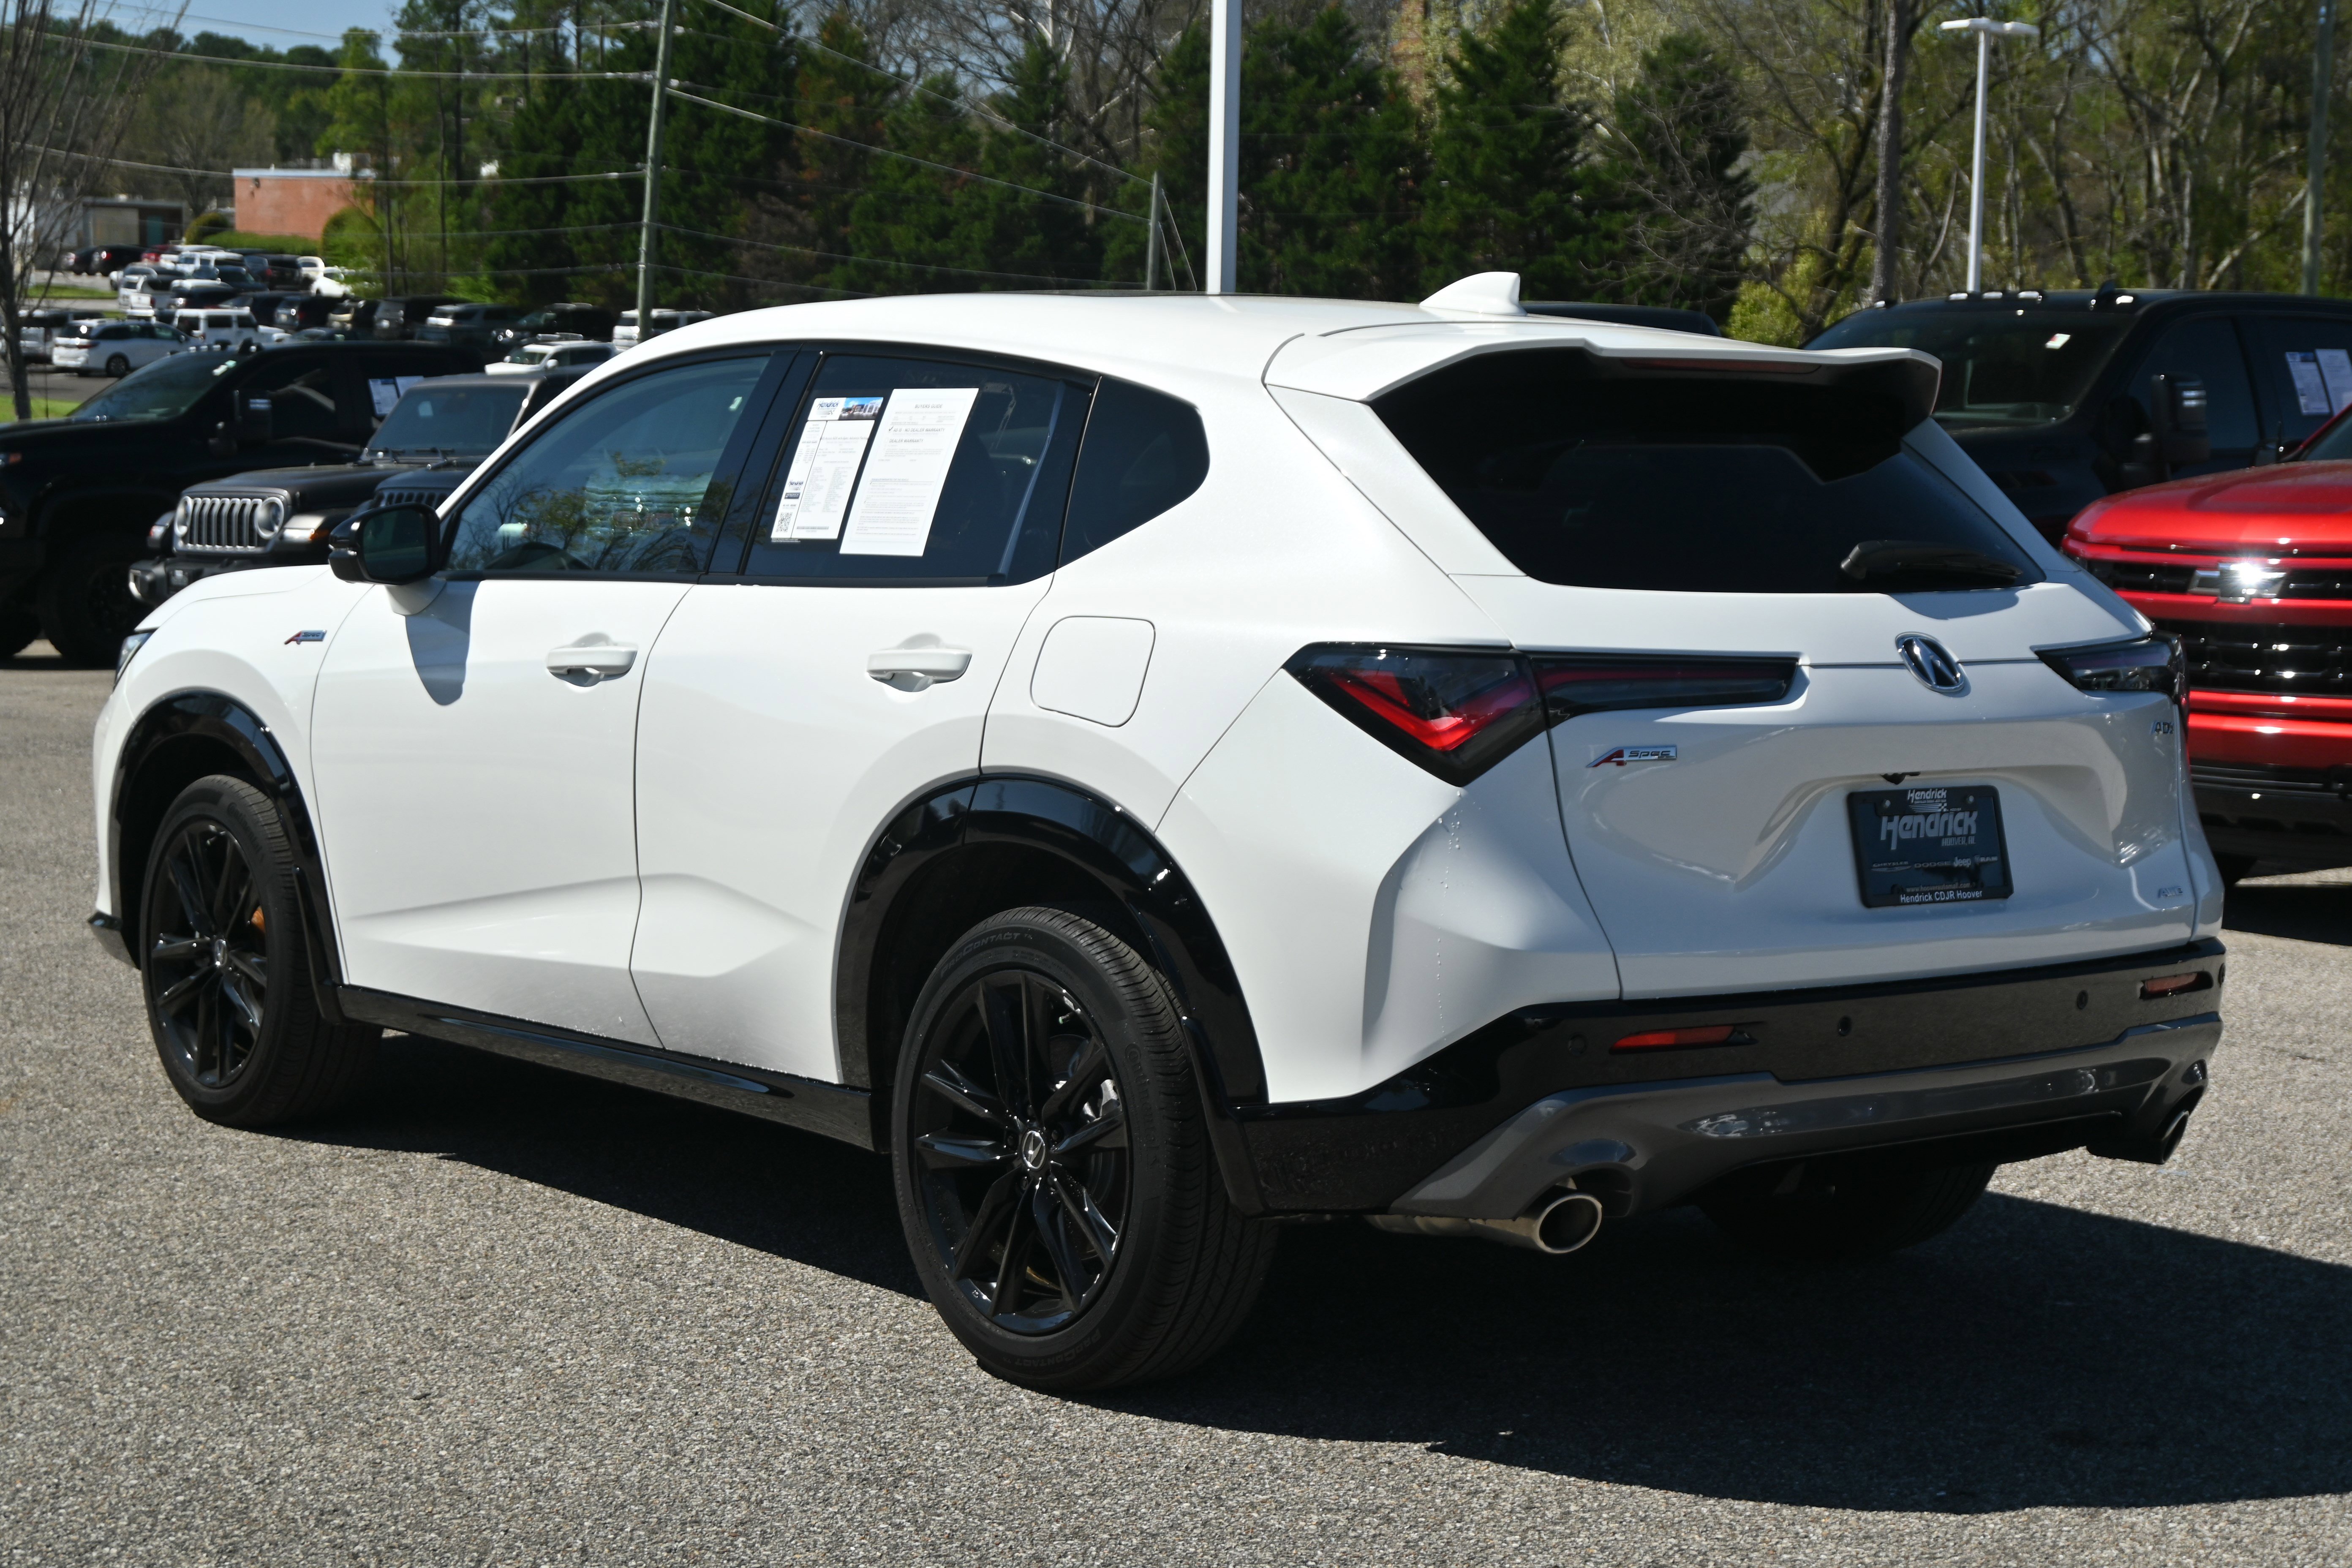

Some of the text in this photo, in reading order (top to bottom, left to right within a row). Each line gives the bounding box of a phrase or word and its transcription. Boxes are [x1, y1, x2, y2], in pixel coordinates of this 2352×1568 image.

[817, 400, 840, 410] Hendrick
[1907, 788, 1947, 803] Hendrick
[1880, 811, 1978, 851] Hendrick
[1941, 836, 1976, 847] HOOVER, AL
[1953, 856, 1971, 867] Jeep
[1906, 882, 1971, 892] www.hooverautomall.com
[1900, 889, 1982, 903] Hendrick CDJR Hoover
